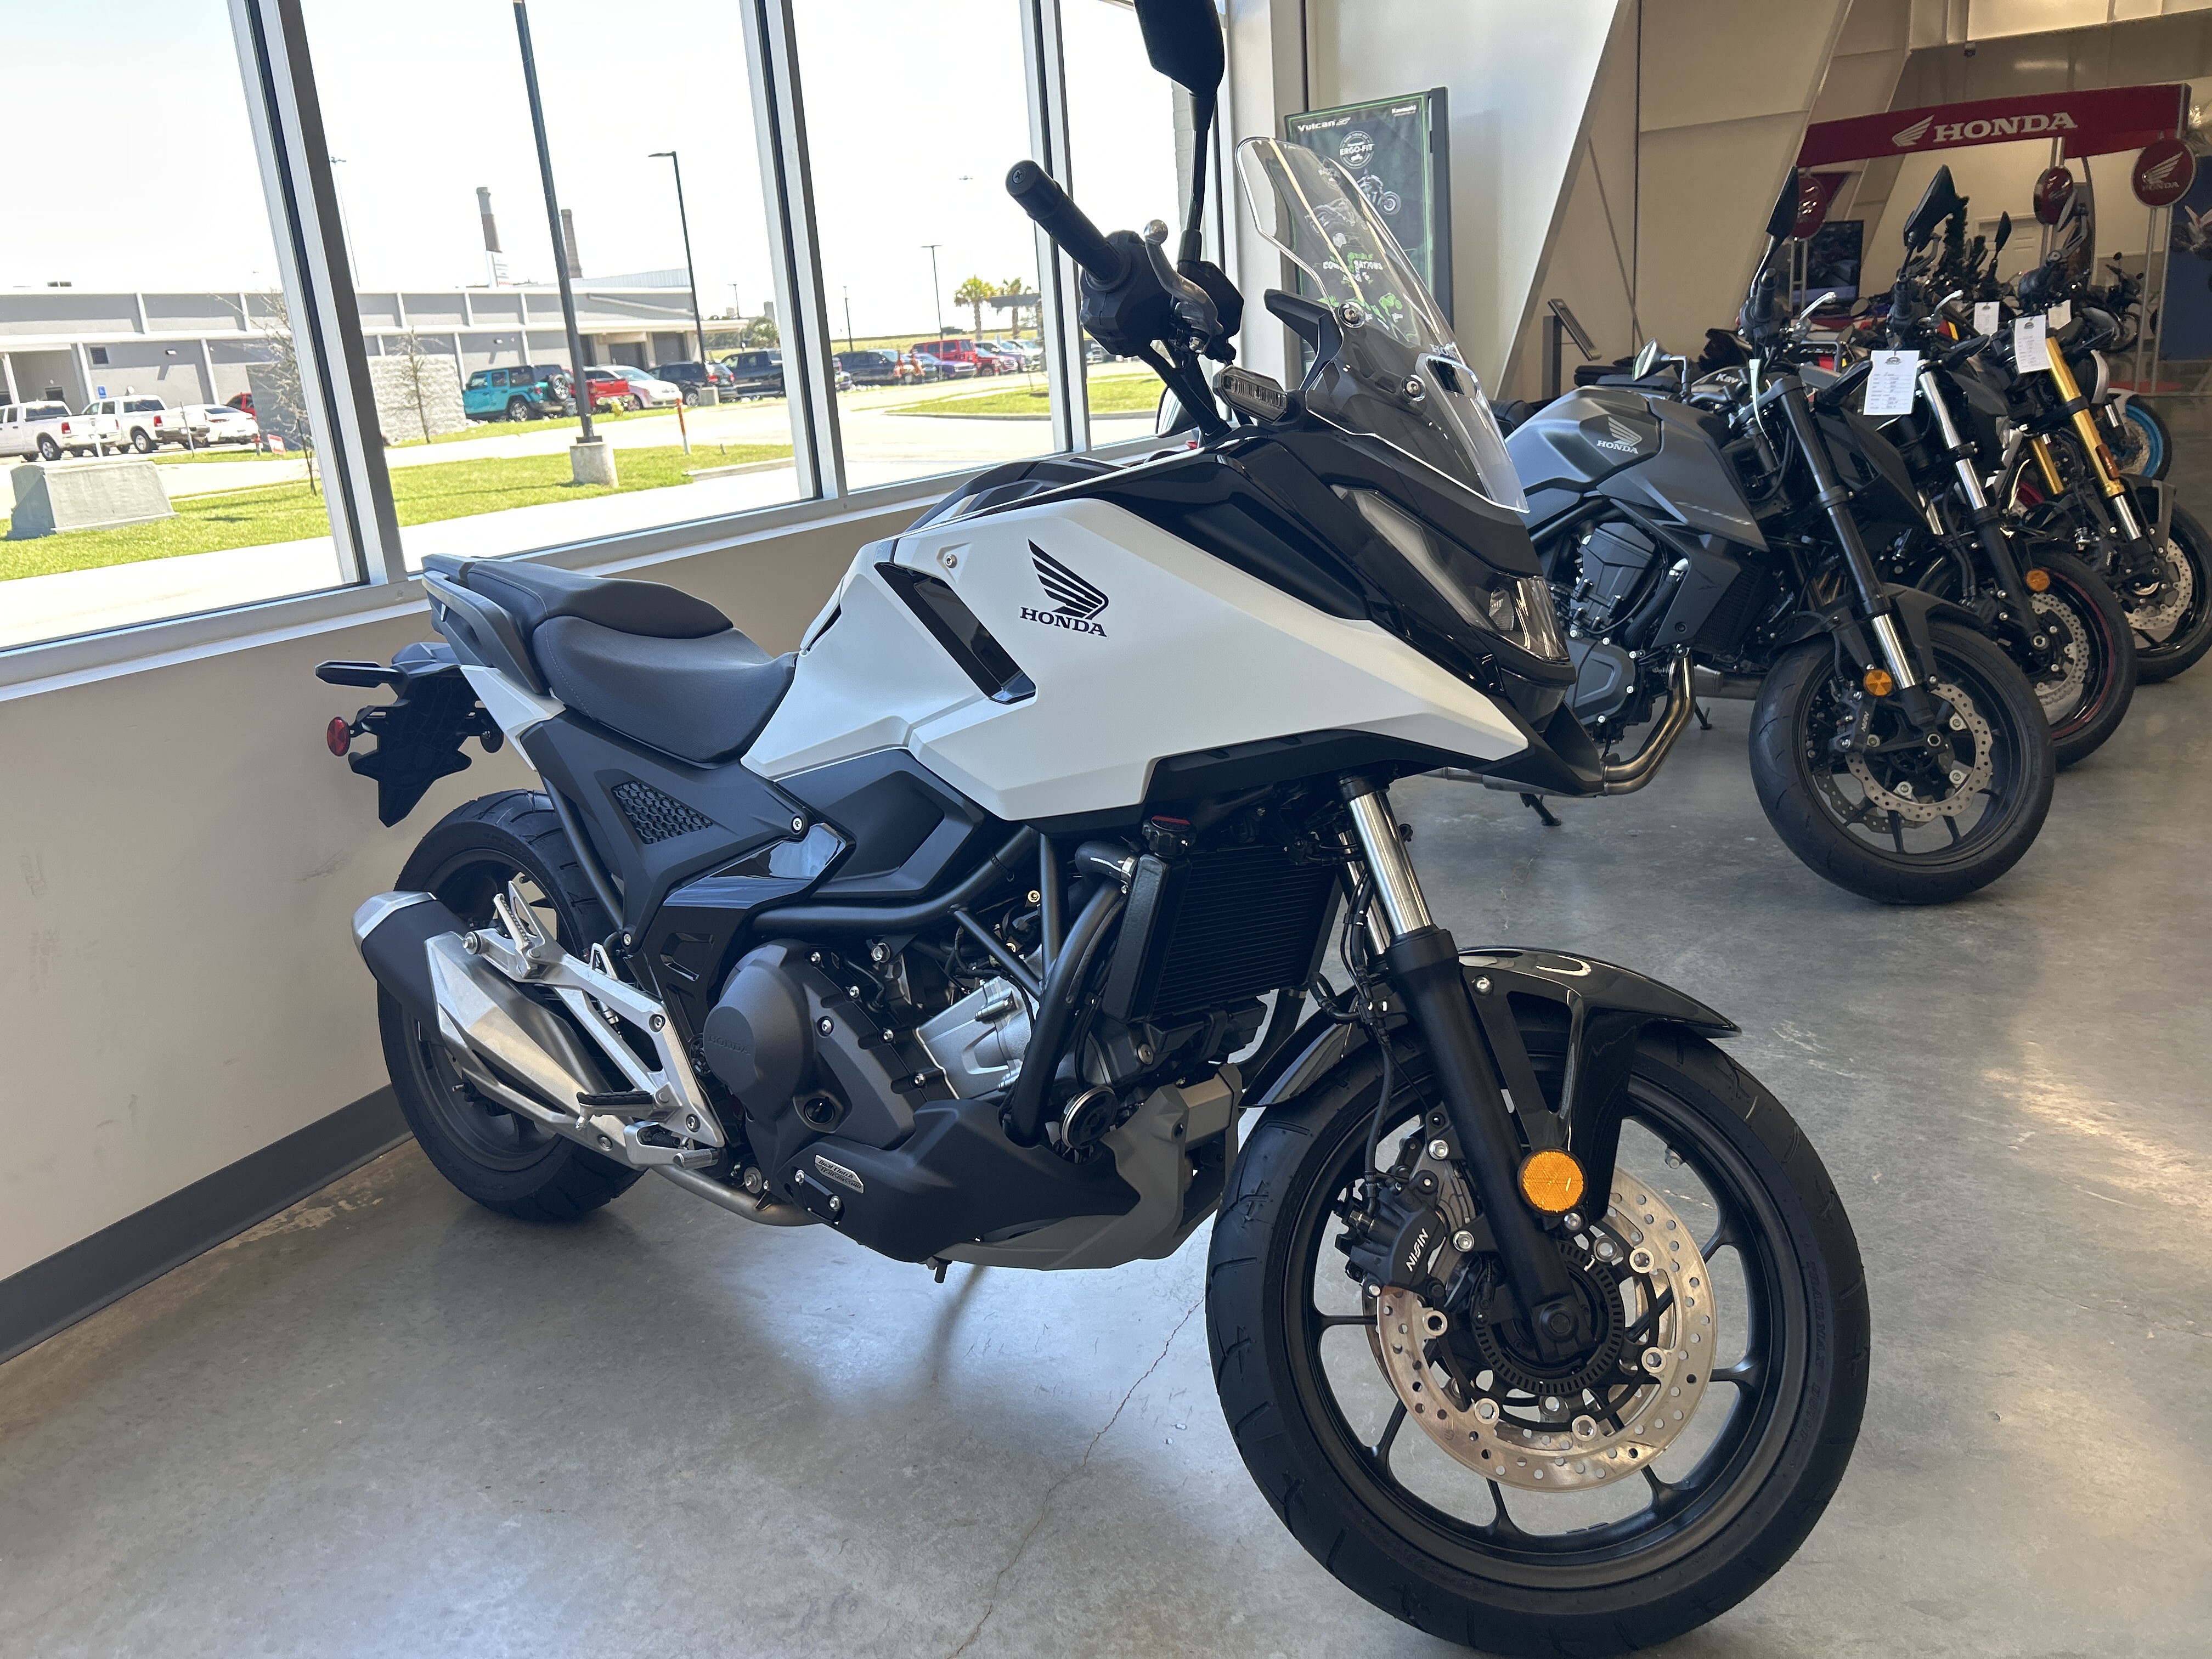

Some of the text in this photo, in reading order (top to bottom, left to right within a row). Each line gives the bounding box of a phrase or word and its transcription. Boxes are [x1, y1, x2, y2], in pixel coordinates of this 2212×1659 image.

[1297, 121, 1335, 132] Vulcan
[1933, 112, 2078, 143] HONDA
[1340, 144, 1375, 156] ERGO-FIT
[1596, 440, 1639, 454] HONDA
[1020, 606, 1107, 637] HONDA
[708, 1035, 751, 1056] HONDA
[818, 1160, 853, 1178] Dual Clutch
[820, 1166, 861, 1189] Transmission
[1406, 1227, 1429, 1272] NISSIN
